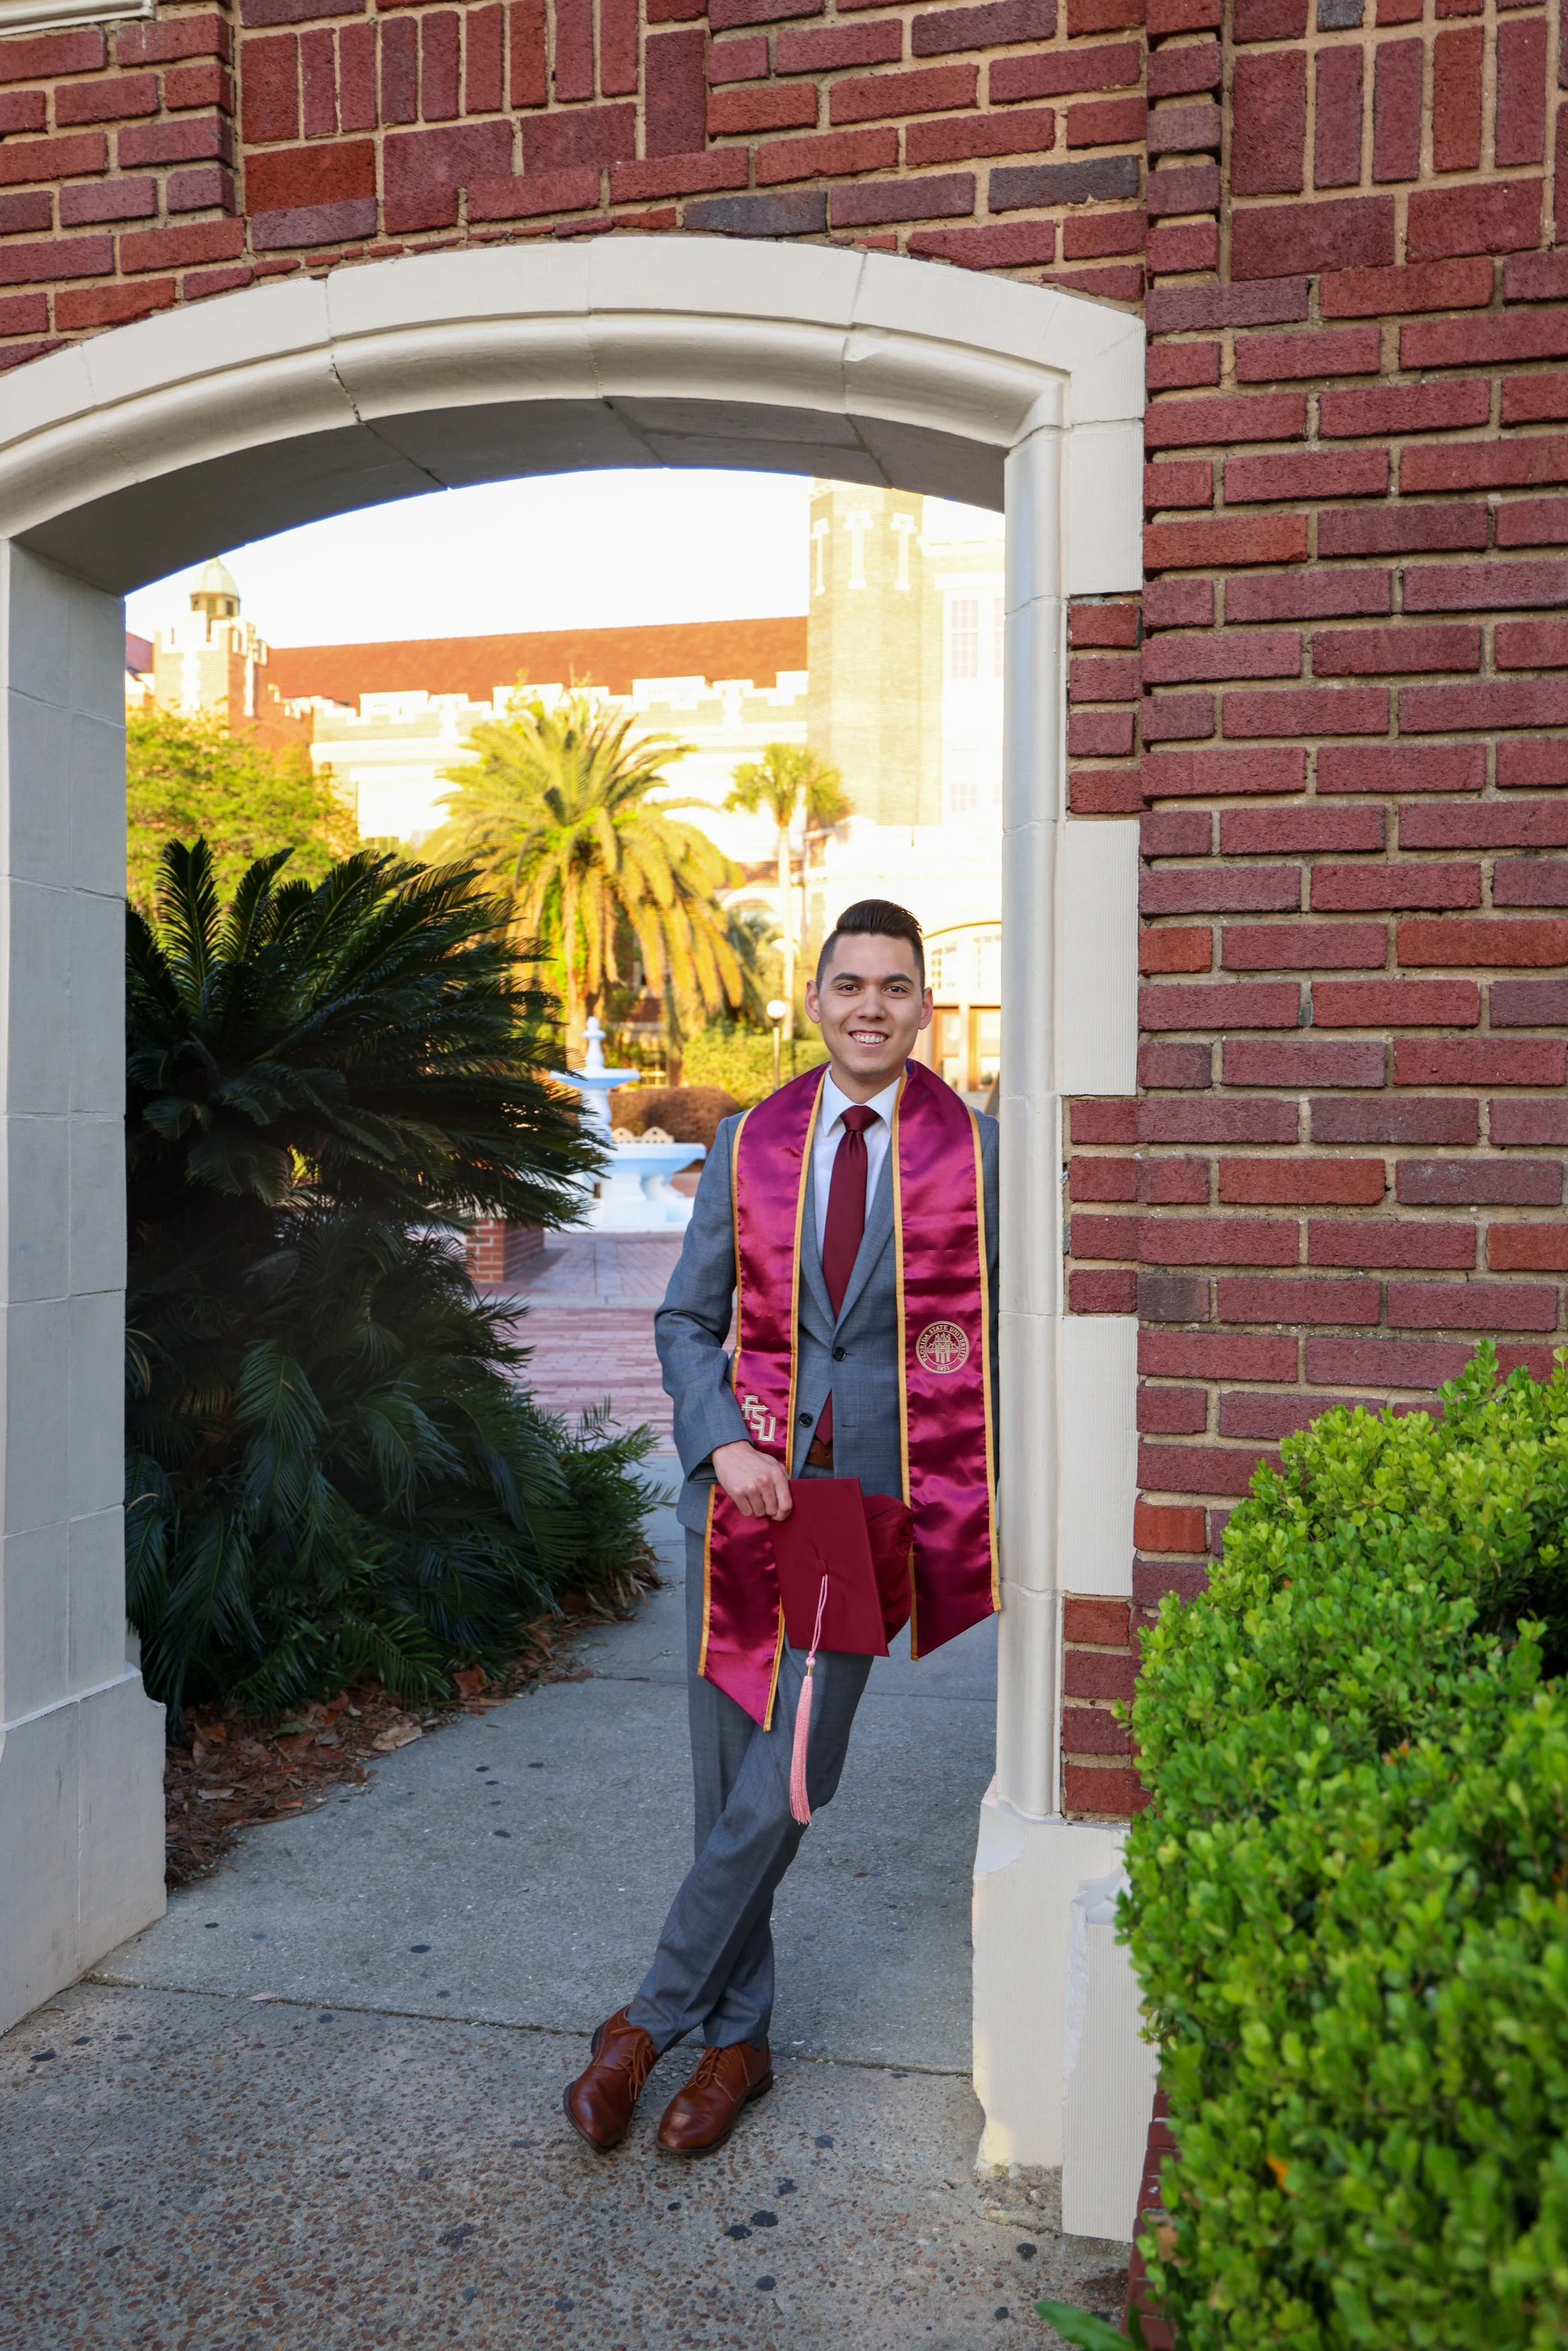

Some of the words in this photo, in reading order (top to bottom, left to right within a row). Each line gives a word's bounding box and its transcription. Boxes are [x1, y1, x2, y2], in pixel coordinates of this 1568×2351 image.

[919, 1334, 929, 1362] FLORIDA
[928, 1325, 948, 1334] STATE
[949, 1327, 966, 1362] UNIVERSITY
[741, 1395, 776, 1441] FSU
